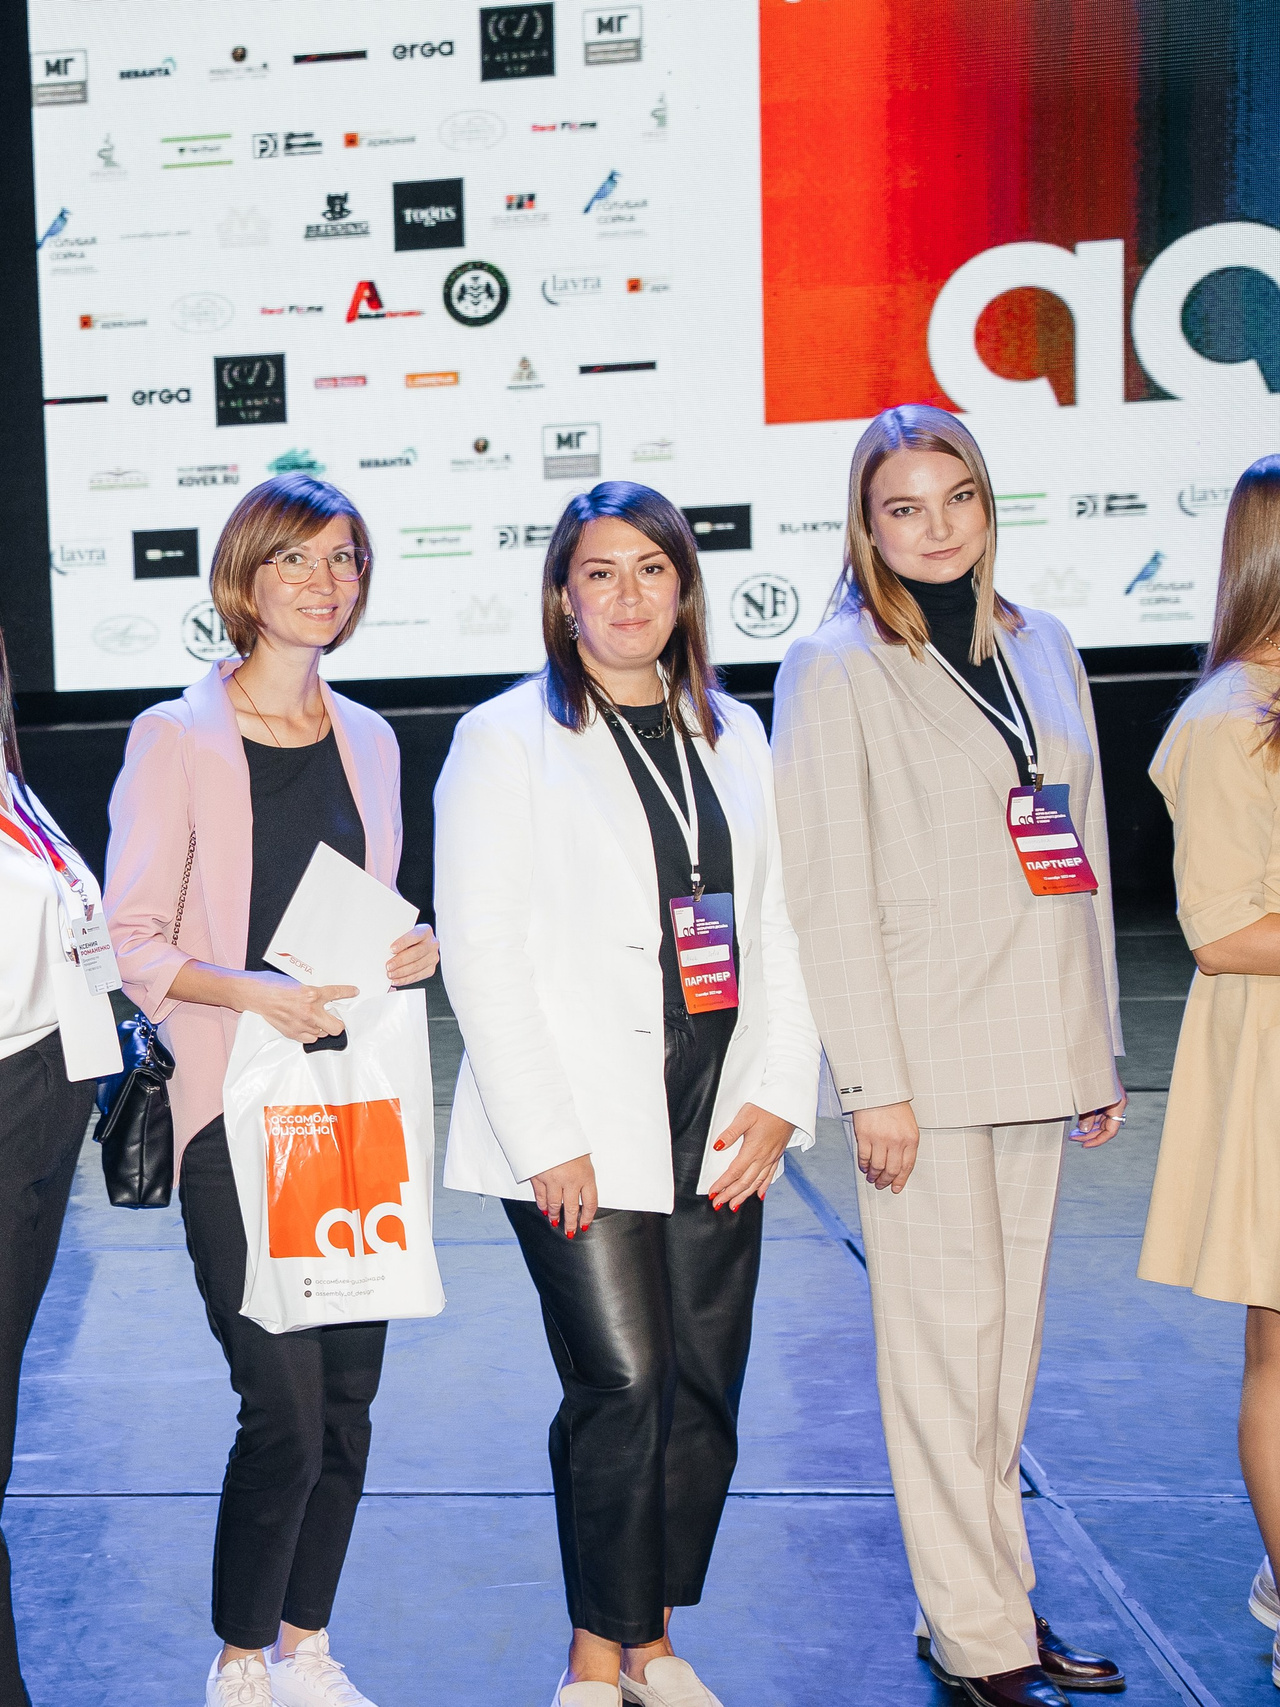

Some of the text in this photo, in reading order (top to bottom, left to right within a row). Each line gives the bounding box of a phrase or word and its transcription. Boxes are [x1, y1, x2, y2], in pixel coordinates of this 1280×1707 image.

[596, 15, 629, 35] МГ
[45, 57, 75, 77] МГ
[556, 431, 587, 451] МГ
[1026, 857, 1083, 870] ПАРТНЕР
[80, 945, 110, 955] РОМАНЕНКО
[289, 956, 314, 976] SOFIA
[685, 971, 731, 987] ПАРТНЕР
